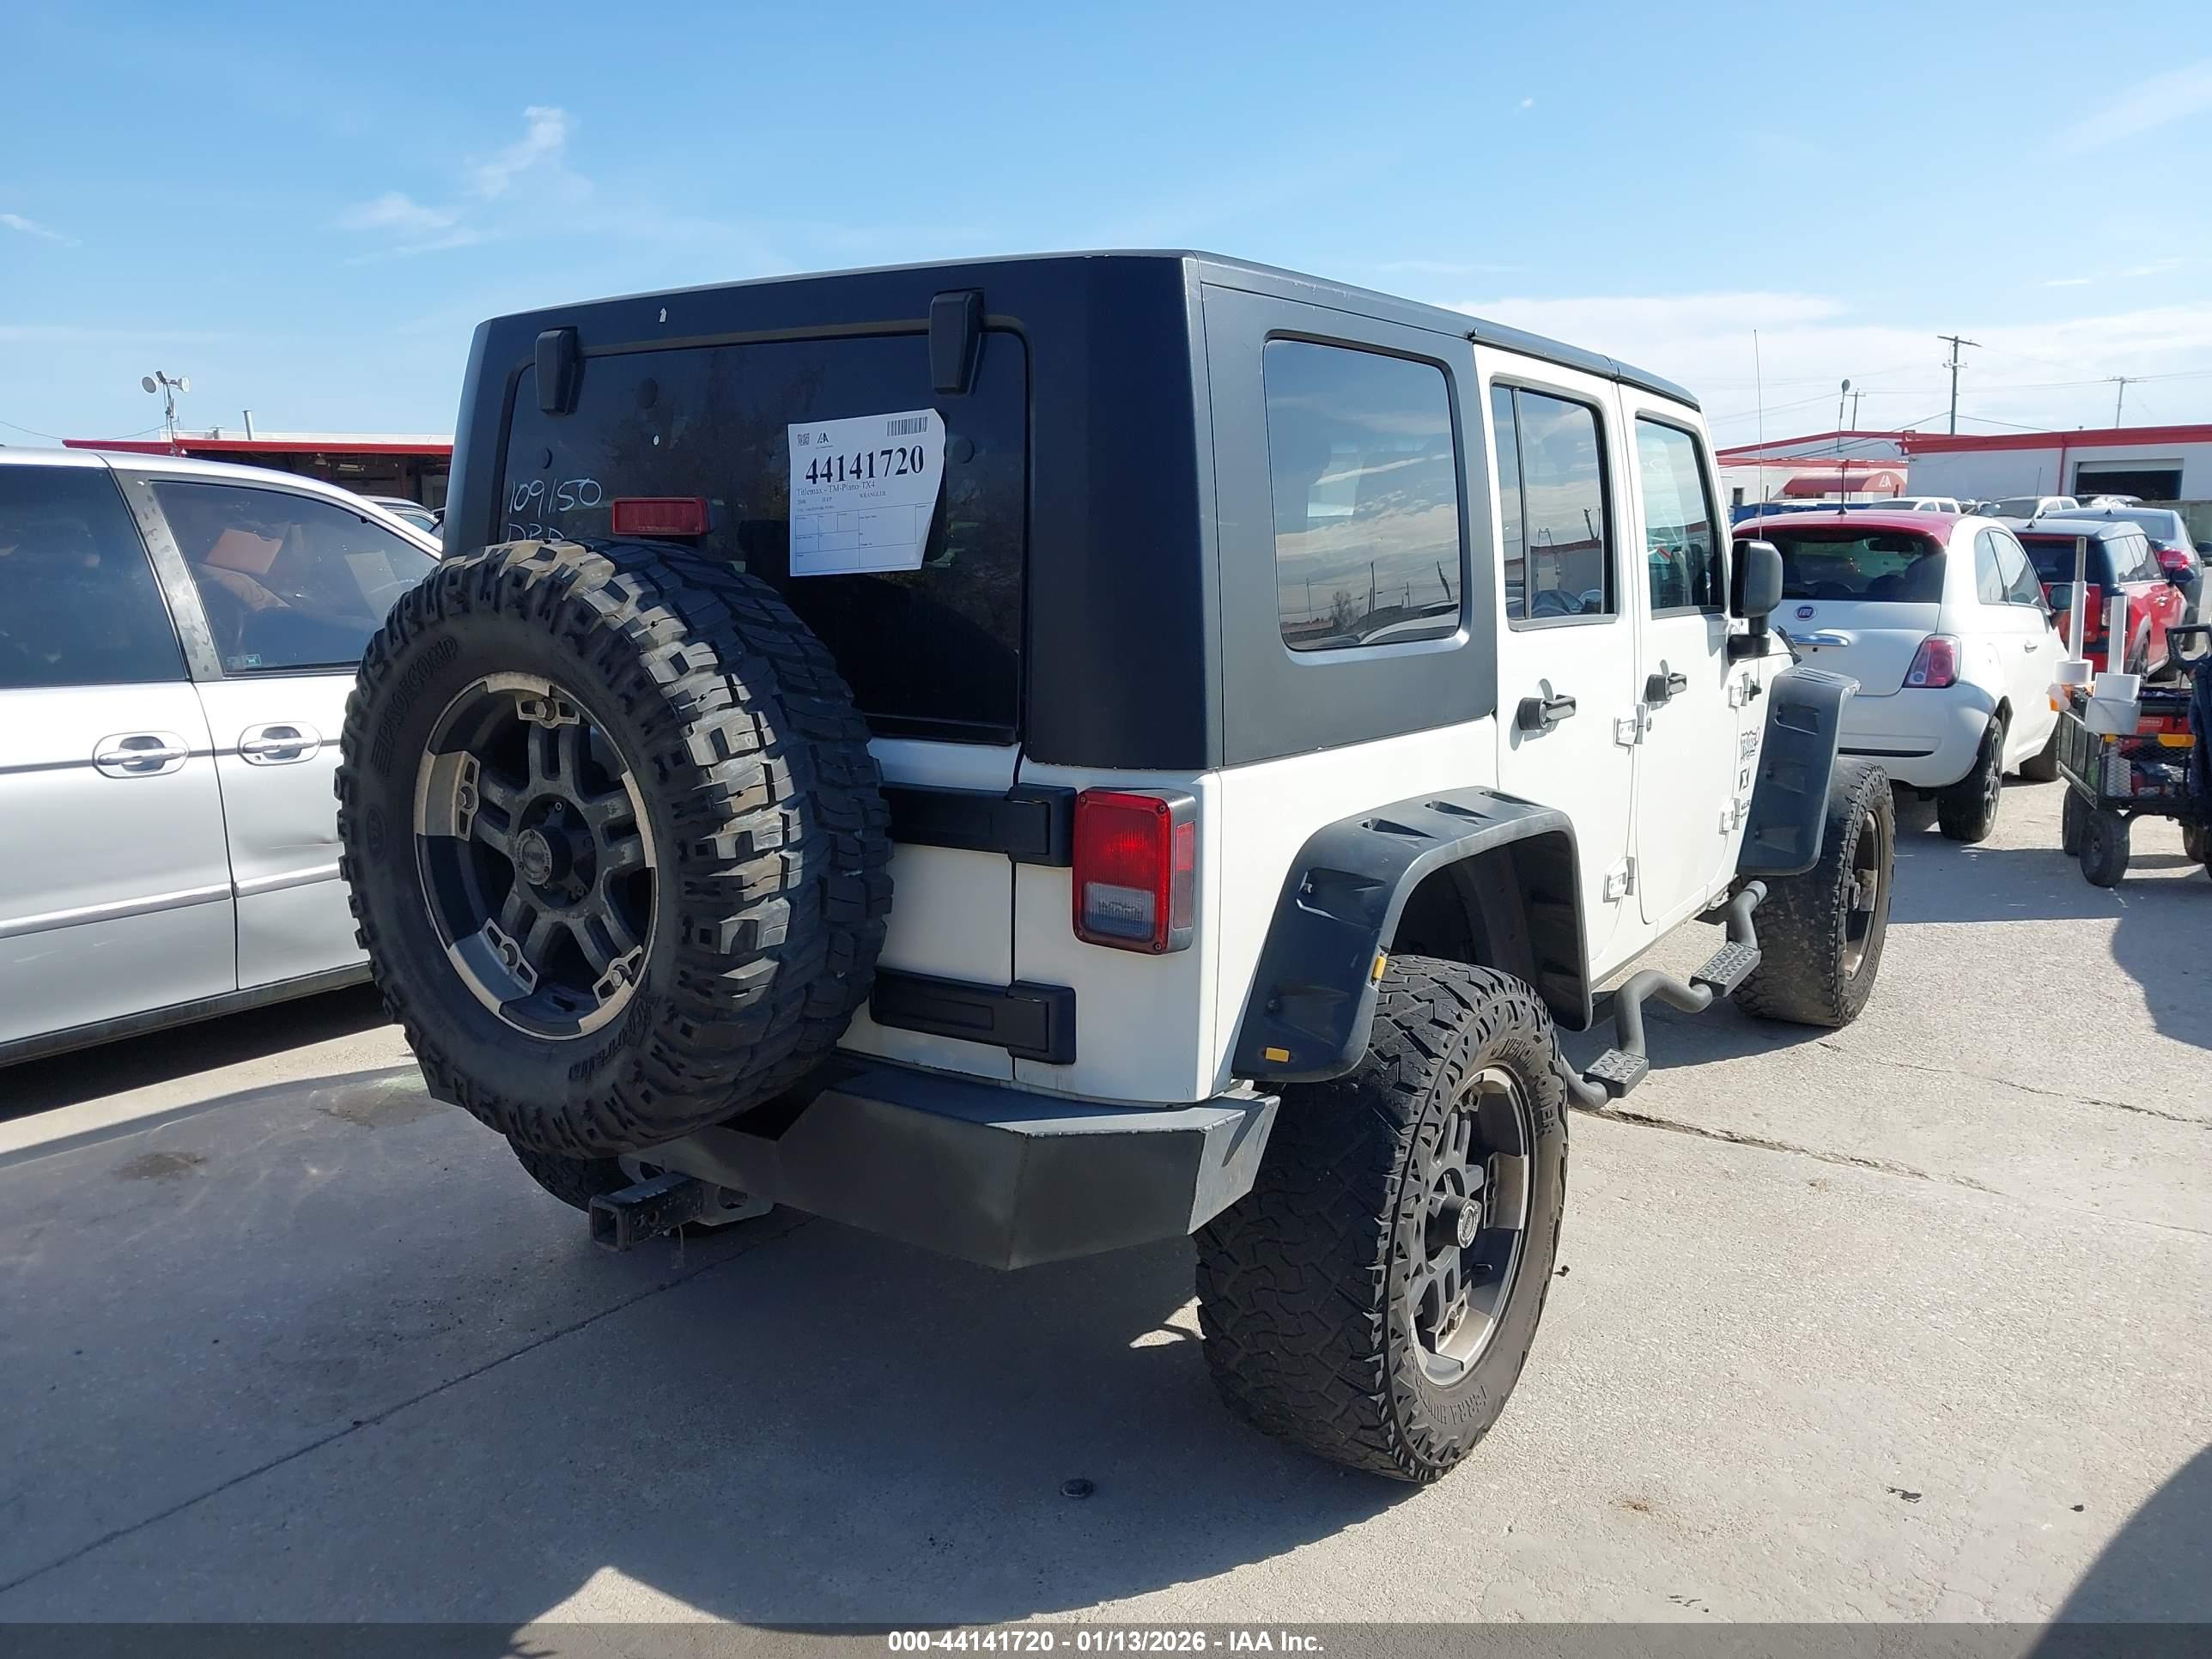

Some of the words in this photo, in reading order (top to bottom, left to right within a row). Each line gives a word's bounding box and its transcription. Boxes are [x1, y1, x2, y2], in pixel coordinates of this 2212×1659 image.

[805, 445, 924, 485] 44141720
[508, 477, 602, 519] 109150
[797, 487, 823, 496] Titlemax
